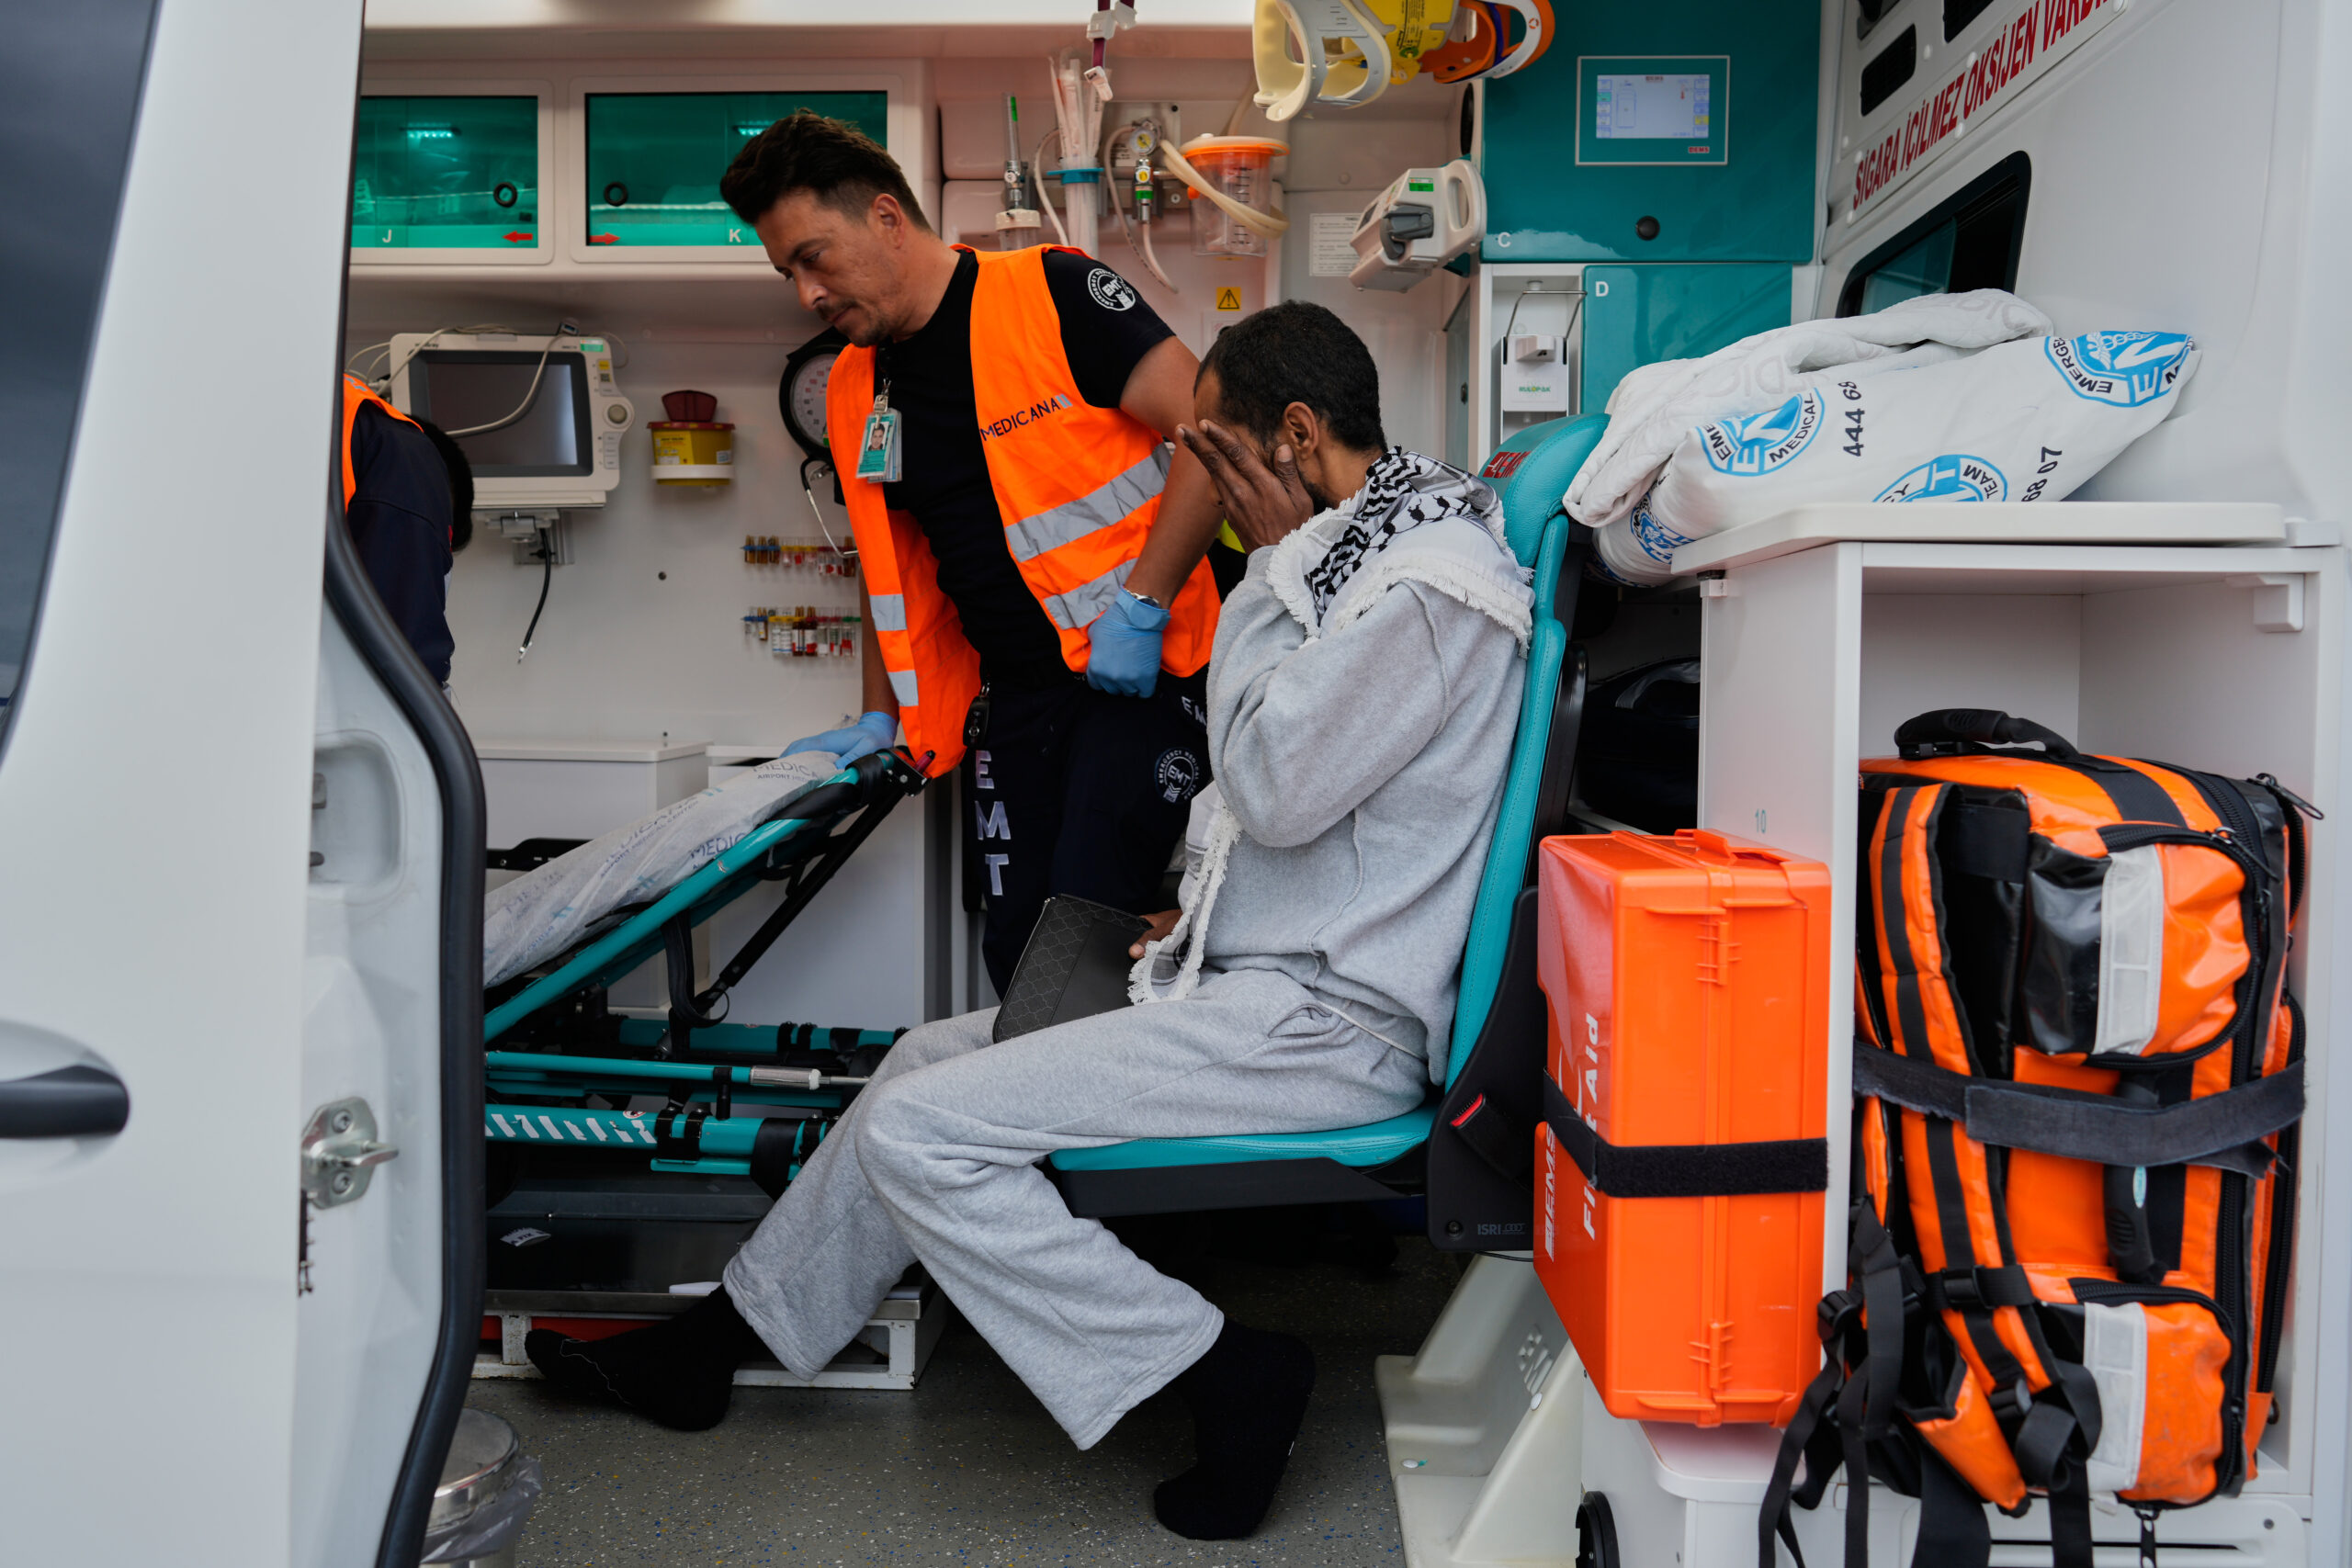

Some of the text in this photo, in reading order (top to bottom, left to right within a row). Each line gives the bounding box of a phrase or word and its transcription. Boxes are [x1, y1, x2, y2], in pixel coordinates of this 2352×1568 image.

[1853, 128, 1901, 210] SİGARA
[1901, 72, 1965, 171] İÇİLMEZ
[1964, 0, 2041, 120] OKSİJEN
[382, 229, 392, 243] J
[729, 228, 741, 243] K
[1498, 232, 1511, 248] C
[1102, 278, 1122, 297] EMT
[1595, 281, 1610, 297] D
[2053, 337, 2113, 393] EMERGE
[979, 397, 1061, 441] MEDICANA
[1769, 390, 1816, 463] MEDICAL
[1844, 409, 1865, 457] 444
[2038, 446, 2063, 475] 07
[1962, 465, 1998, 499] TEAM
[1182, 695, 1207, 726] EM
[1168, 764, 1191, 785] EMT
[1585, 1012, 1599, 1104] Aid
[1477, 1224, 1502, 1235] ISRI
